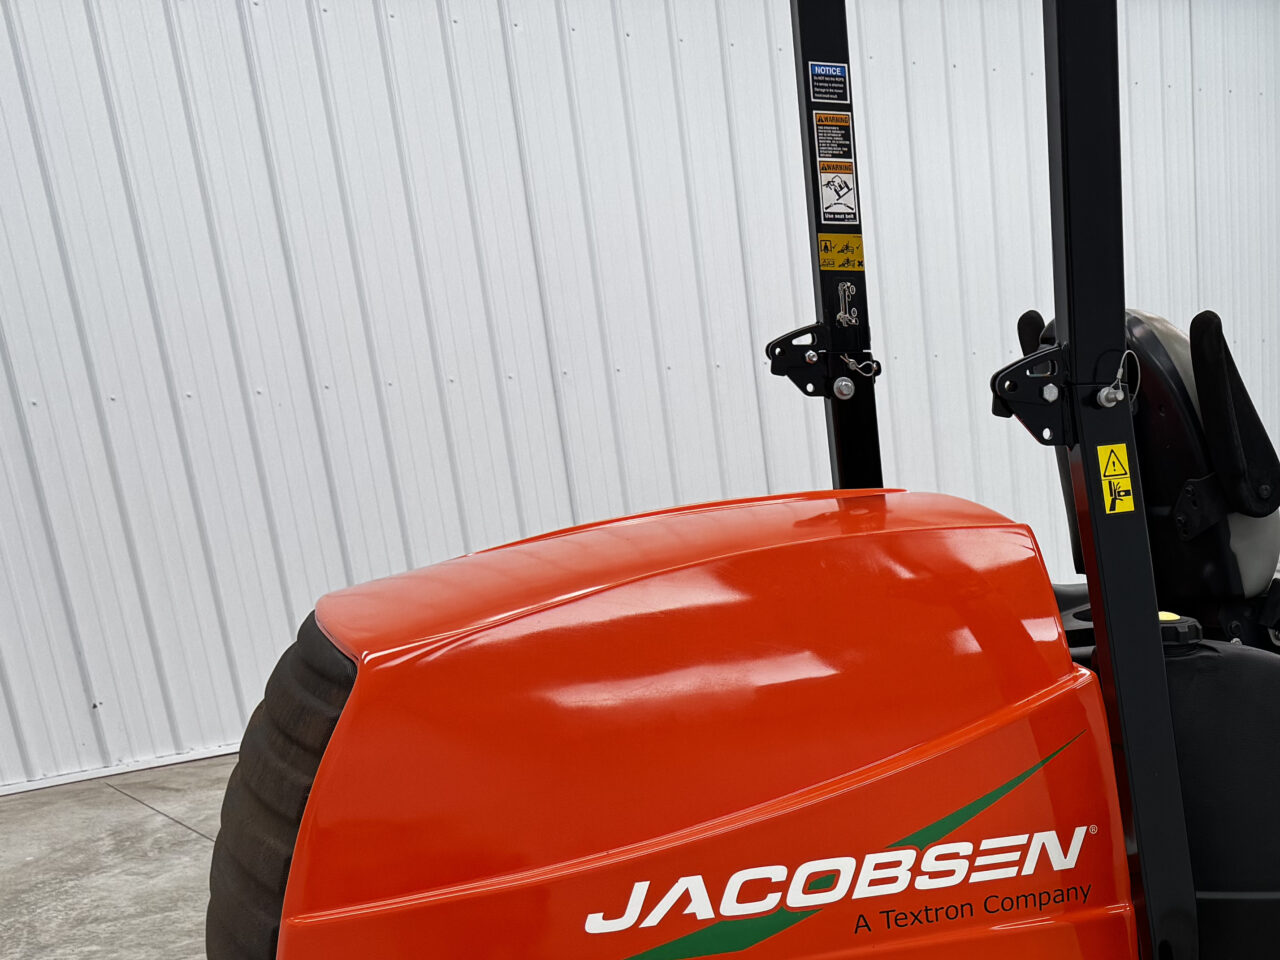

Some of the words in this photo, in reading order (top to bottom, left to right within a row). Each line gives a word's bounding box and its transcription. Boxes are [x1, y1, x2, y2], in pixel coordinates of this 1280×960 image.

[815, 66, 842, 76] NOTICE
[823, 116, 849, 124] WARNING
[585, 826, 1088, 934] JACOBSEN
[854, 914, 872, 934] A
[880, 902, 974, 929] Textron
[983, 884, 1092, 914] Company
